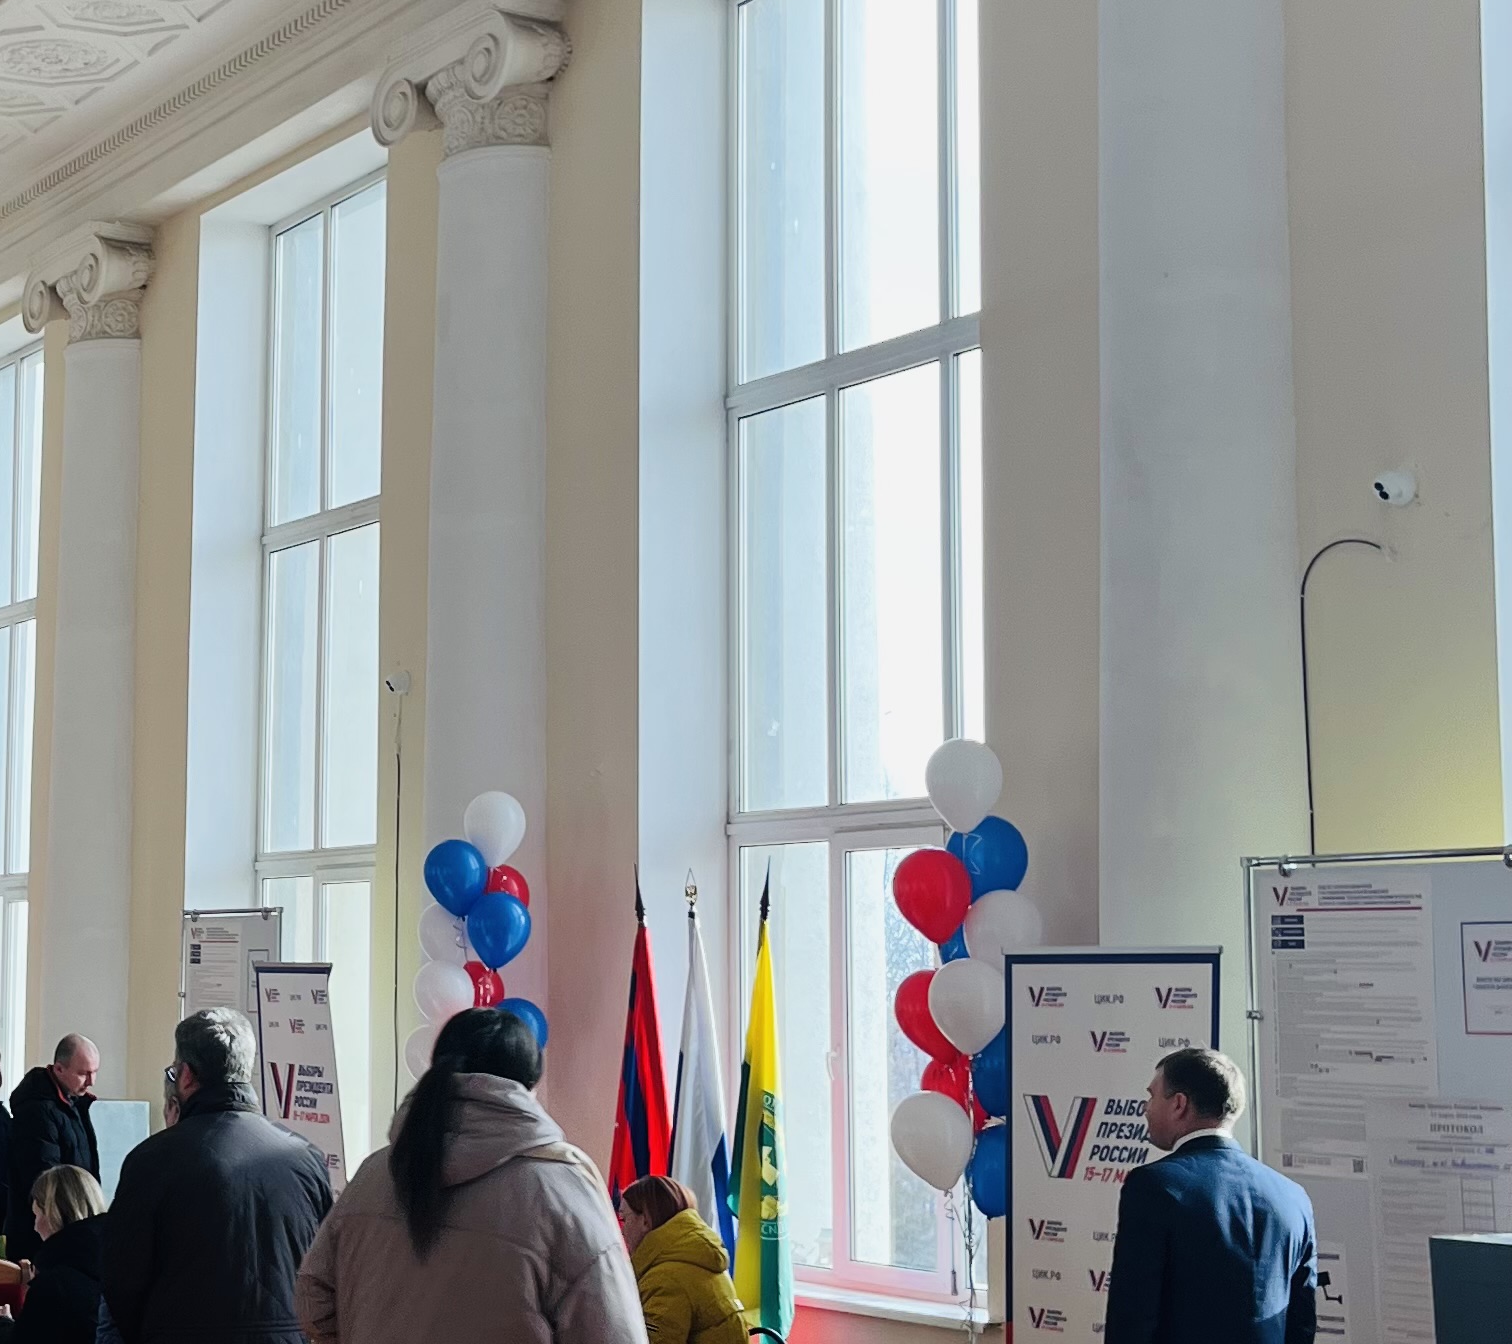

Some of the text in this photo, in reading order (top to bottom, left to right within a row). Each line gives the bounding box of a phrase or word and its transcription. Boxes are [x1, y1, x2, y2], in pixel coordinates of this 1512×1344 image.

[1104, 1099, 1146, 1117] ВЫБО
[1096, 1122, 1150, 1143] ПРЕЗИД
[1430, 1123, 1484, 1134] ПРОТОКОЛ
[1089, 1144, 1149, 1164] РОССИИ
